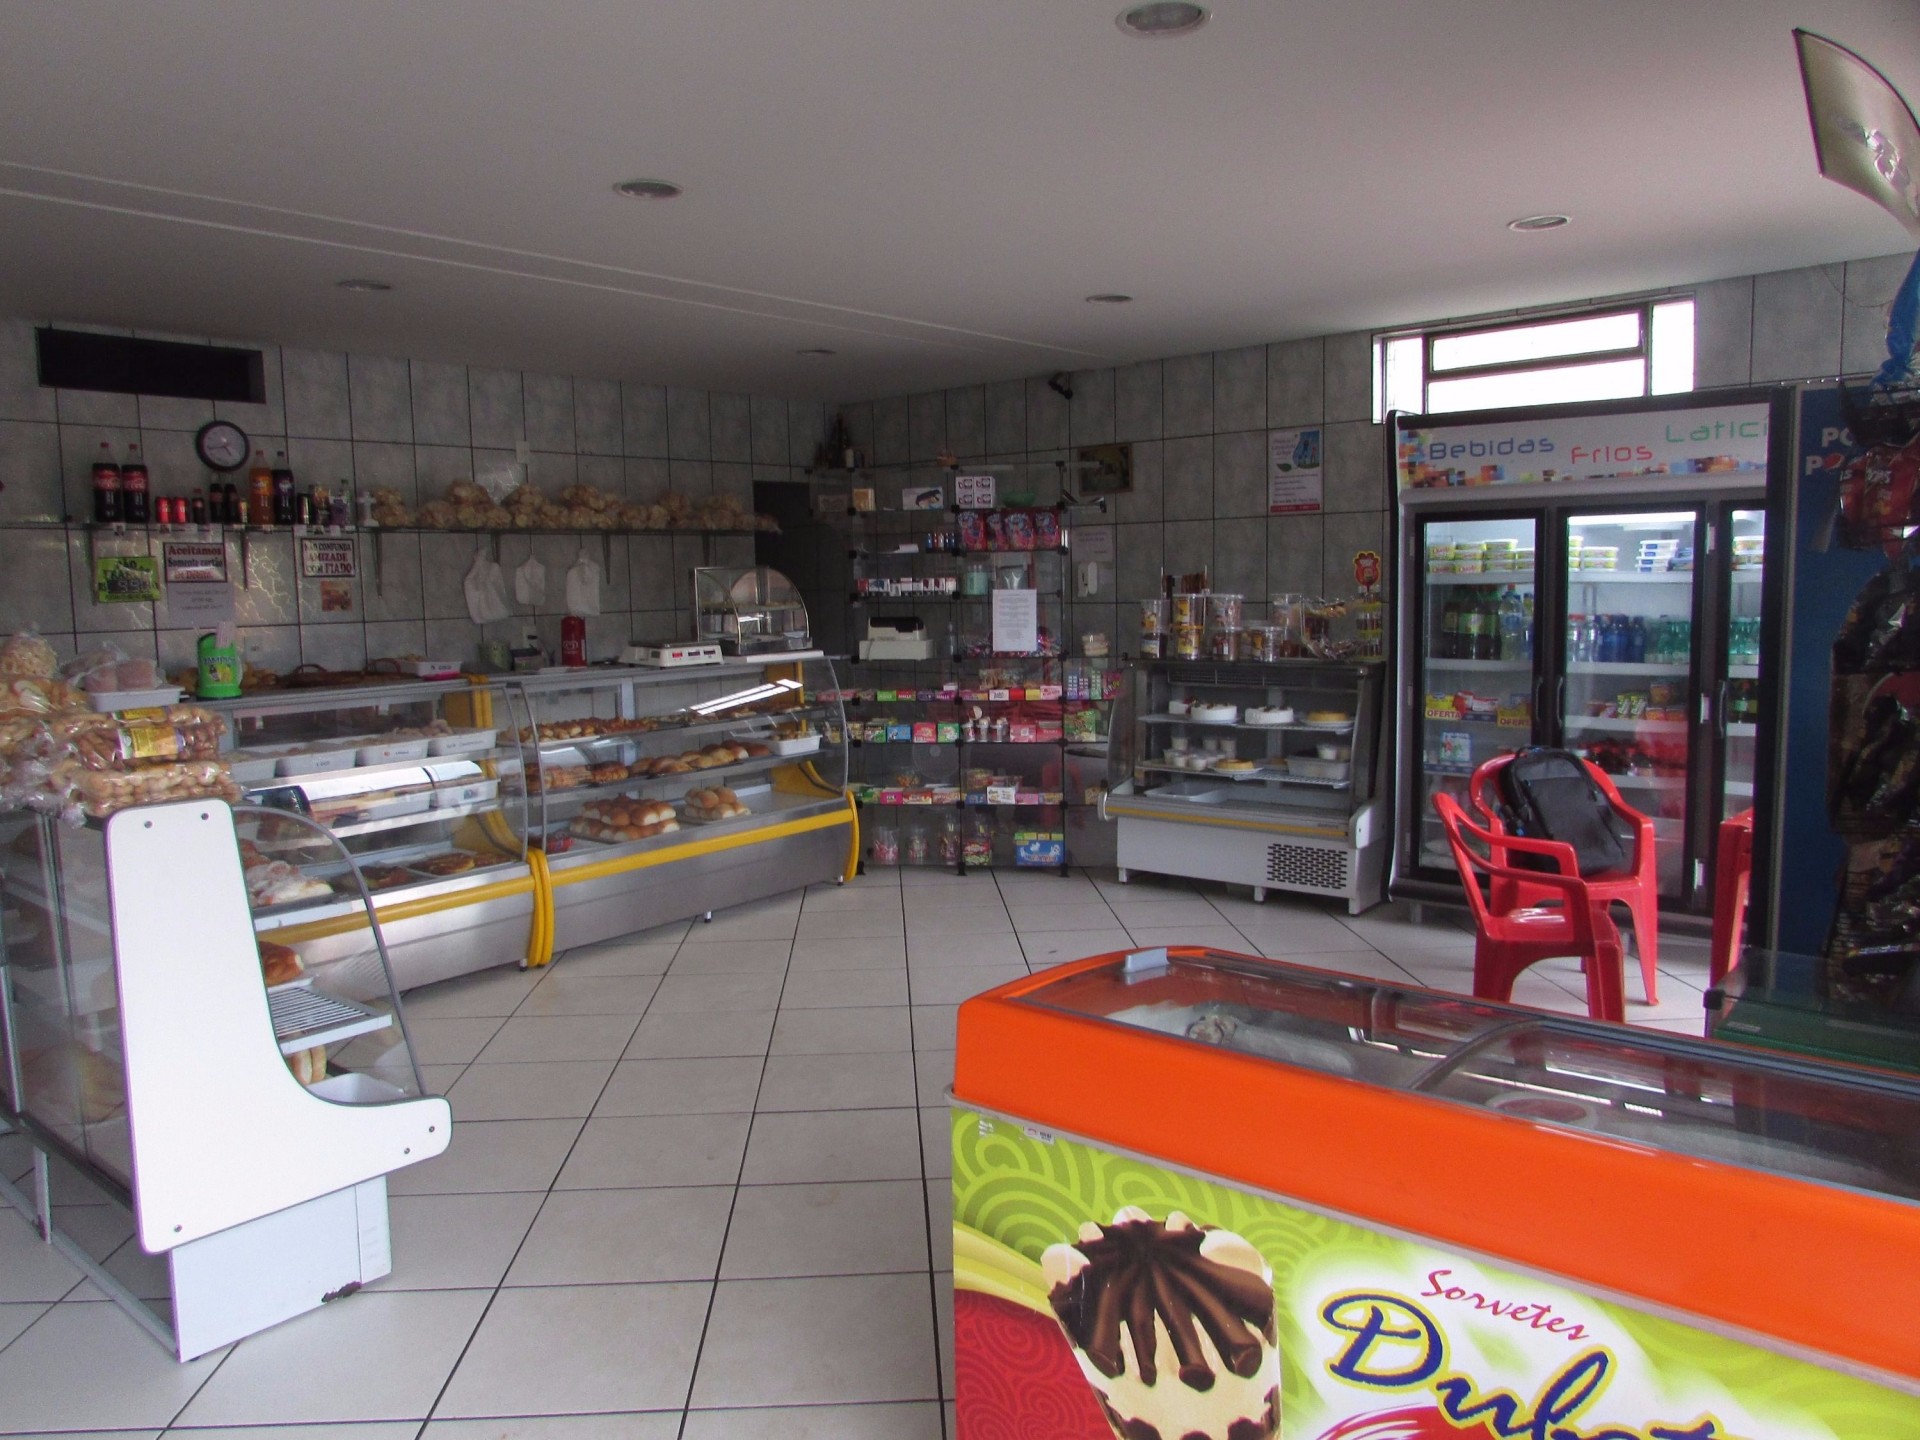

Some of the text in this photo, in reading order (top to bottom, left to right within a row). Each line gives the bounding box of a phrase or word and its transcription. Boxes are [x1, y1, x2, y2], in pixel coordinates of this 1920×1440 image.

[1429, 437, 1554, 460] Bebidas
[1570, 445, 1653, 464] Frios
[168, 545, 222, 556] Aceitamos
[318, 543, 352, 551] CONFUNDA
[168, 557, 199, 567] Somente
[309, 552, 348, 562] AMIZADE
[325, 563, 353, 574] FIADO
[1427, 710, 1462, 719] OFERTA
[1501, 717, 1532, 726] OFERT
[1420, 1268, 1589, 1341] Sorvetes
